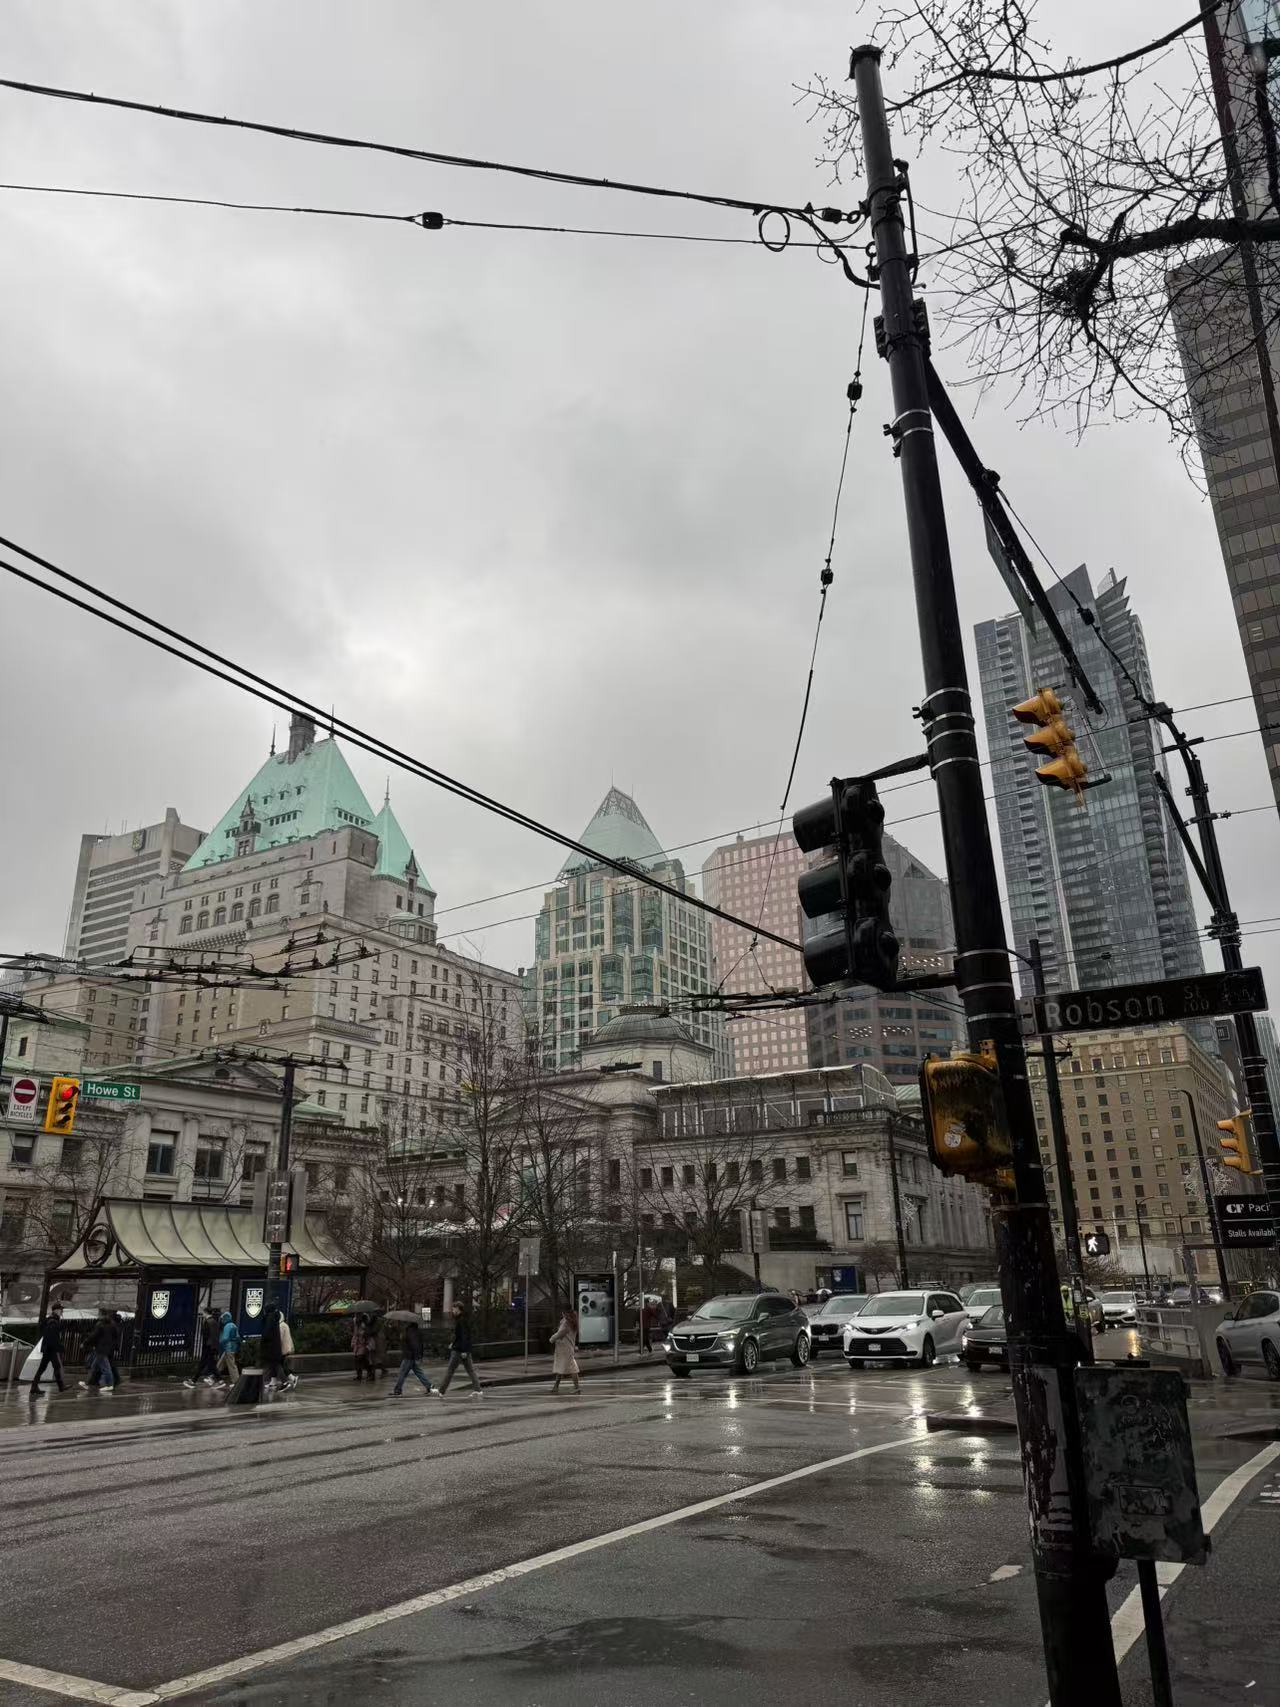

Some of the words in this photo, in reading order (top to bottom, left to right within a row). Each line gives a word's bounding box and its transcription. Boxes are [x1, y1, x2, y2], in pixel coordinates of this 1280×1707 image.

[1044, 995, 1164, 1028] Robson
[87, 1083, 118, 1096] Howe
[123, 1086, 136, 1098] St
[1226, 1203, 1245, 1214] CF
[1248, 1202, 1271, 1213] Paci
[1227, 1229, 1247, 1238] Stalls
